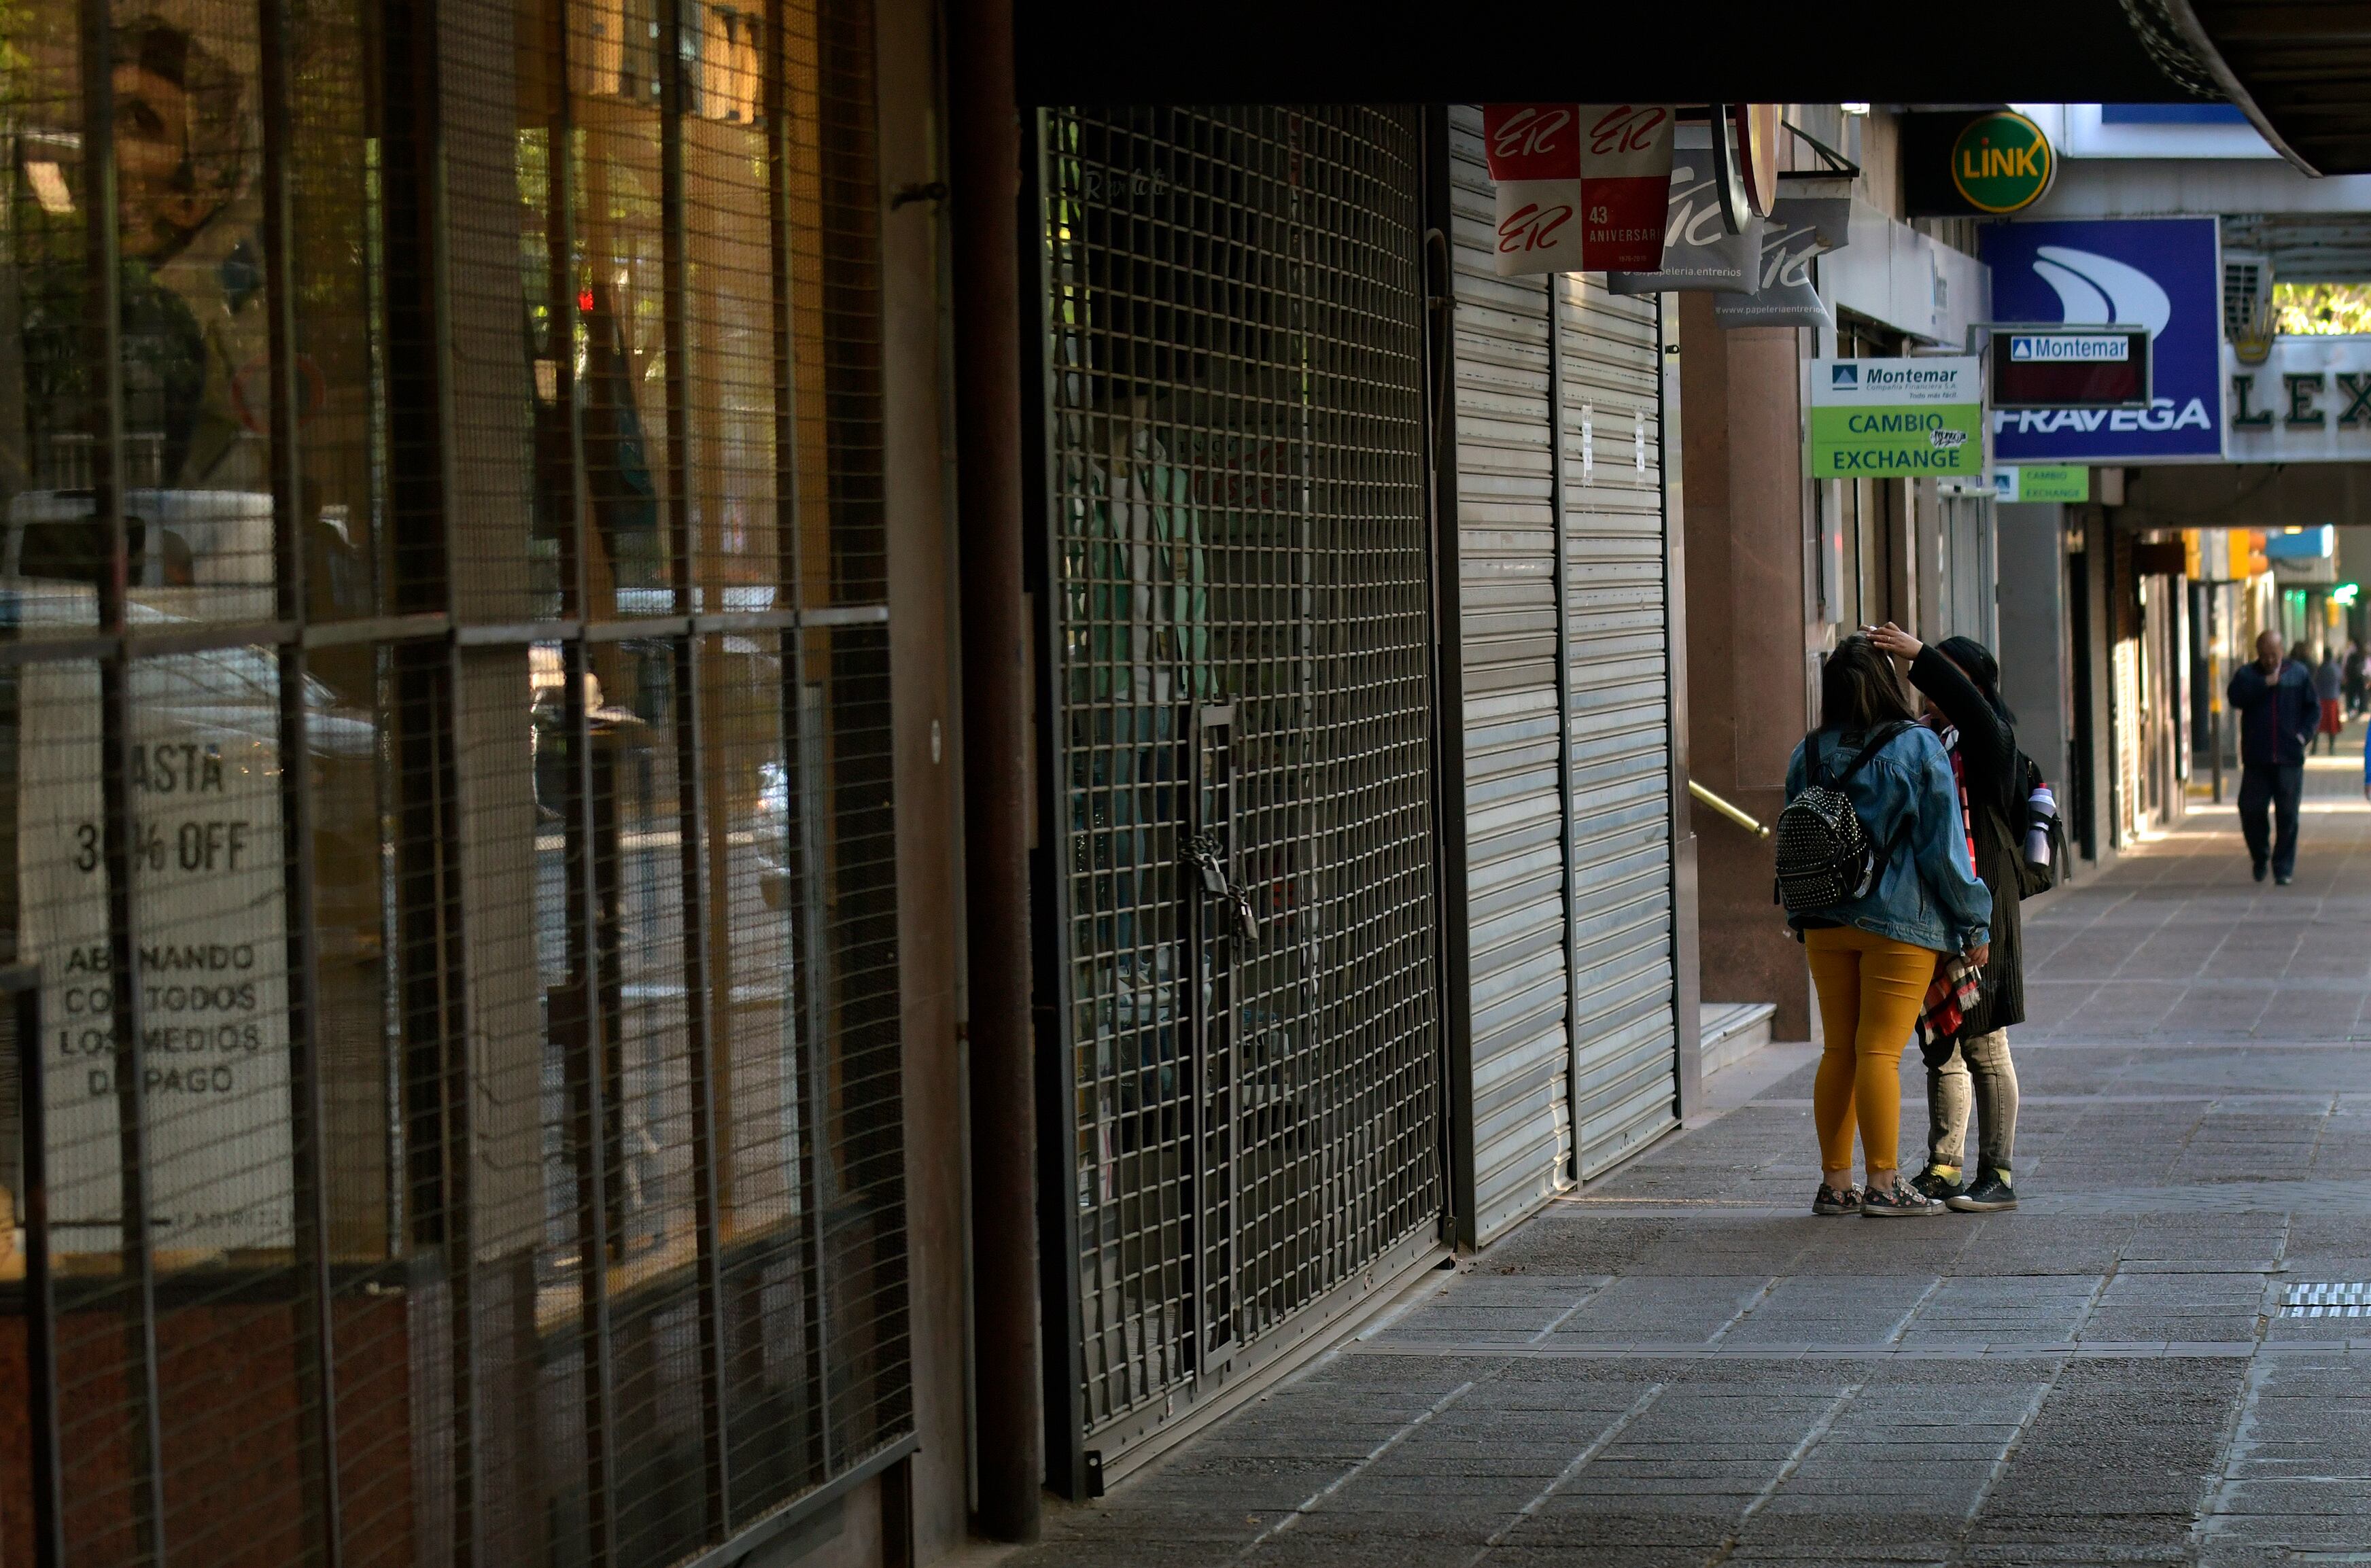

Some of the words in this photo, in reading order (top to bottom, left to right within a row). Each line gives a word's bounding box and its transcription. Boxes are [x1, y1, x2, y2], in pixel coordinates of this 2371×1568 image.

[1963, 137, 2041, 178] LINK
[1589, 206, 1608, 224] 43
[2036, 338, 2127, 358] Montemar
[1867, 368, 1958, 384] Montemar
[1848, 414, 1943, 433] CAMBIO
[1834, 449, 1960, 470] EXCHANGE
[131, 743, 223, 792] ASTA
[77, 822, 166, 871] 3%
[179, 821, 249, 871] OFF
[67, 945, 254, 972] ABNANDO
[66, 988, 113, 1013] CO
[145, 986, 256, 1011] TODOS
[144, 1065, 232, 1093] PAGO
